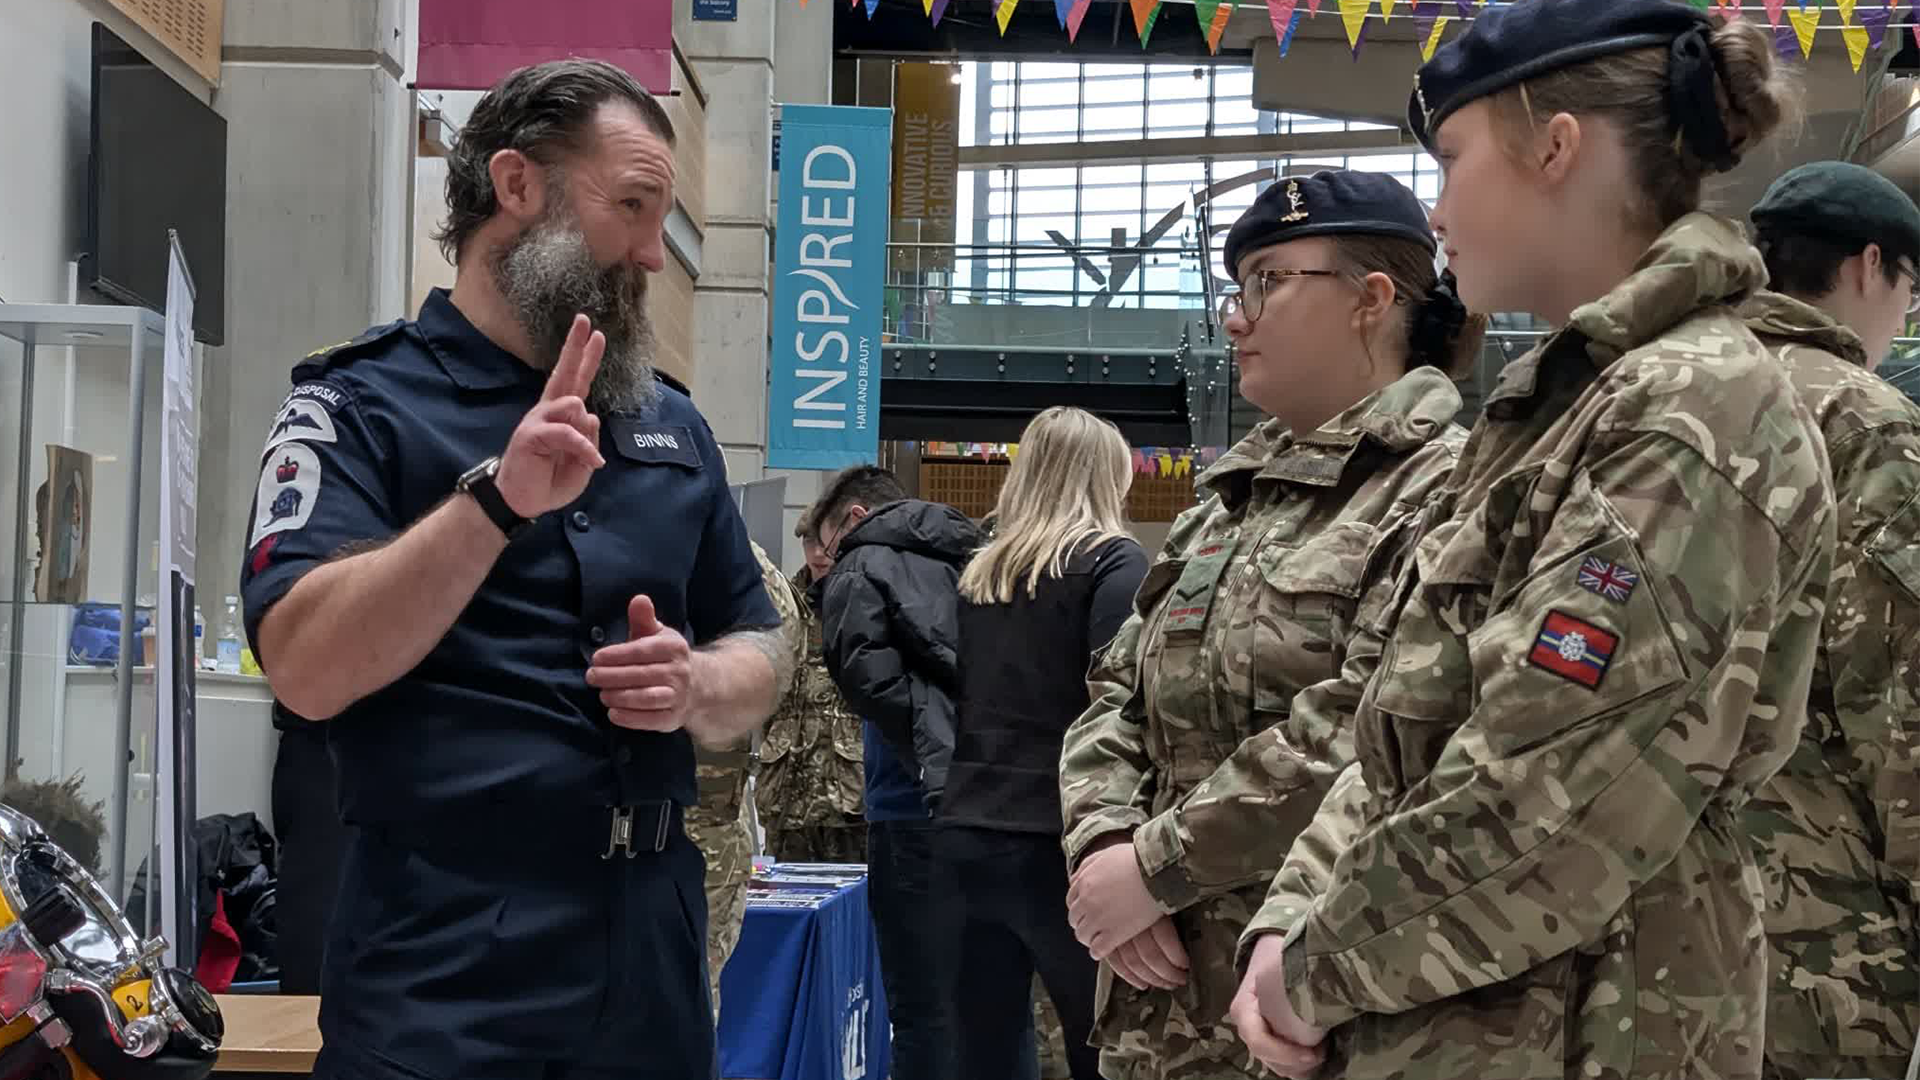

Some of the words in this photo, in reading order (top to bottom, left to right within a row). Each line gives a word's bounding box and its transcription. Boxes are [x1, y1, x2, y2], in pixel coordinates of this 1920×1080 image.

[901, 111, 928, 223] INNOVATIVE
[930, 119, 954, 199] CURIOUS
[858, 336, 870, 377] BEAUTY
[293, 385, 341, 406] DISPOSAL
[857, 378, 868, 403] AND
[855, 404, 867, 430] HAIR
[633, 433, 679, 450] BINNS
[126, 995, 144, 1012] 2
